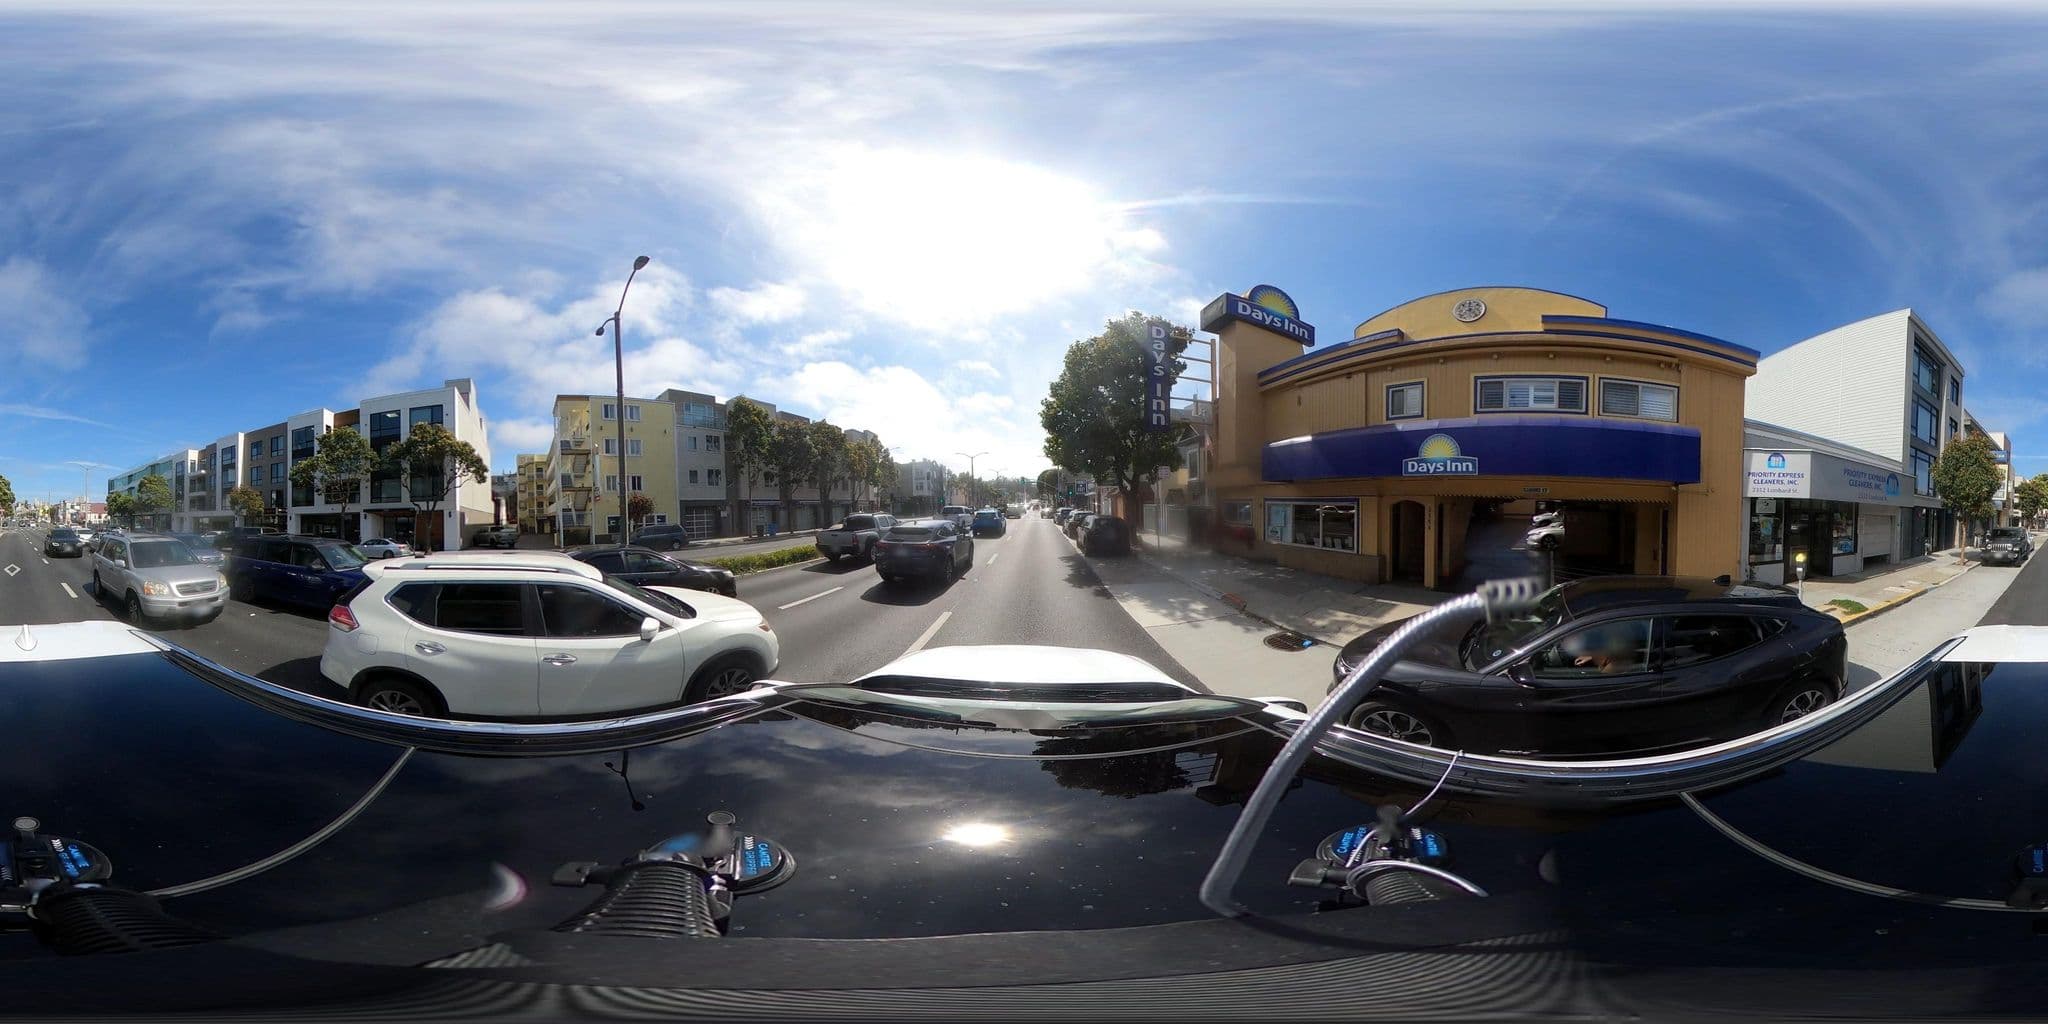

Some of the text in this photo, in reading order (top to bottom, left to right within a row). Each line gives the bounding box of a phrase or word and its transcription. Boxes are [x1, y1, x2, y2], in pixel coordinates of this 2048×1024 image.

[1237, 301, 1309, 339] Days Inn
[1151, 325, 1166, 426] Days Inn
[1407, 460, 1473, 474] Days Inn
